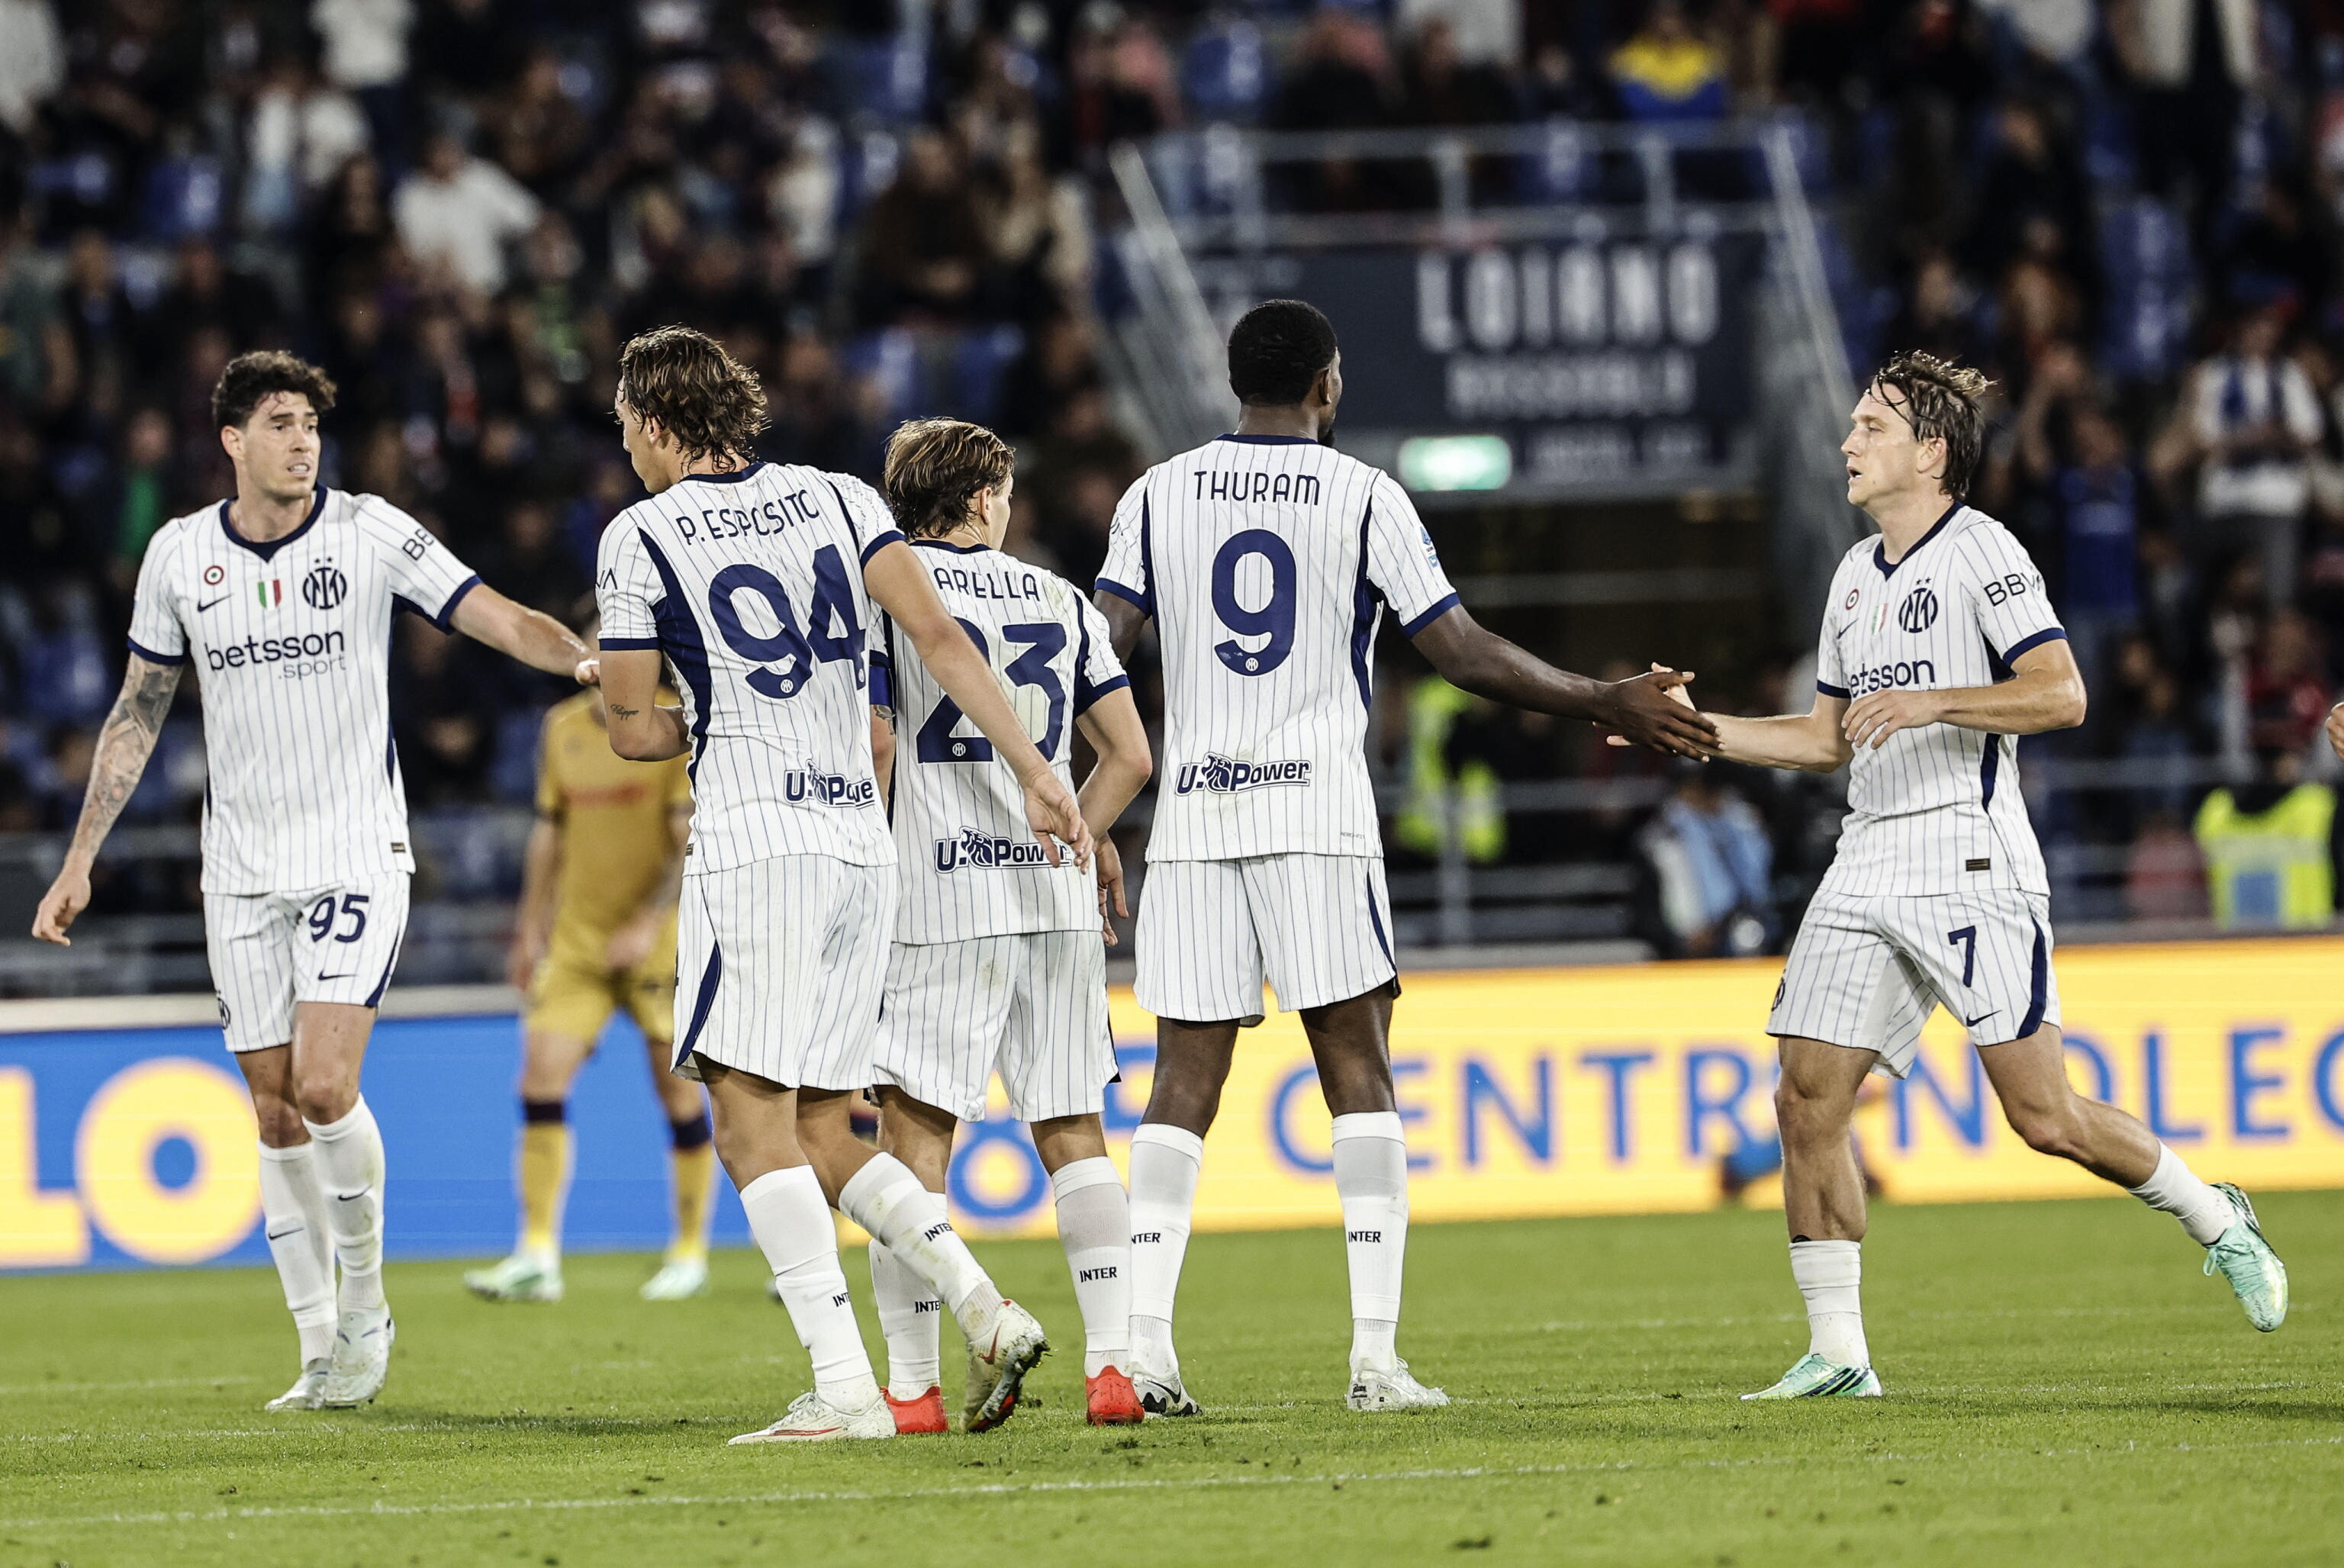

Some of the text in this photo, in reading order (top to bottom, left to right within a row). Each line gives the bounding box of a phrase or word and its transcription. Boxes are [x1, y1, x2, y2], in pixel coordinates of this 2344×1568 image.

[1194, 470, 1321, 506] THURAM
[933, 567, 1041, 602] ARELLA
[1212, 528, 1296, 677] 9
[708, 543, 868, 699] 94
[204, 629, 345, 671] betsson
[1849, 659, 1935, 698] etsson
[308, 893, 370, 944] 95
[1947, 925, 1976, 988] 7
[1274, 1048, 1782, 1174] CENTR
[924, 1222, 953, 1242] INTE
[1131, 1232, 1161, 1244] NTER
[1347, 1231, 1381, 1243] INTER
[1079, 1266, 1117, 1283] INTER
[832, 1292, 851, 1308] INT
[915, 1300, 941, 1313] INTE
